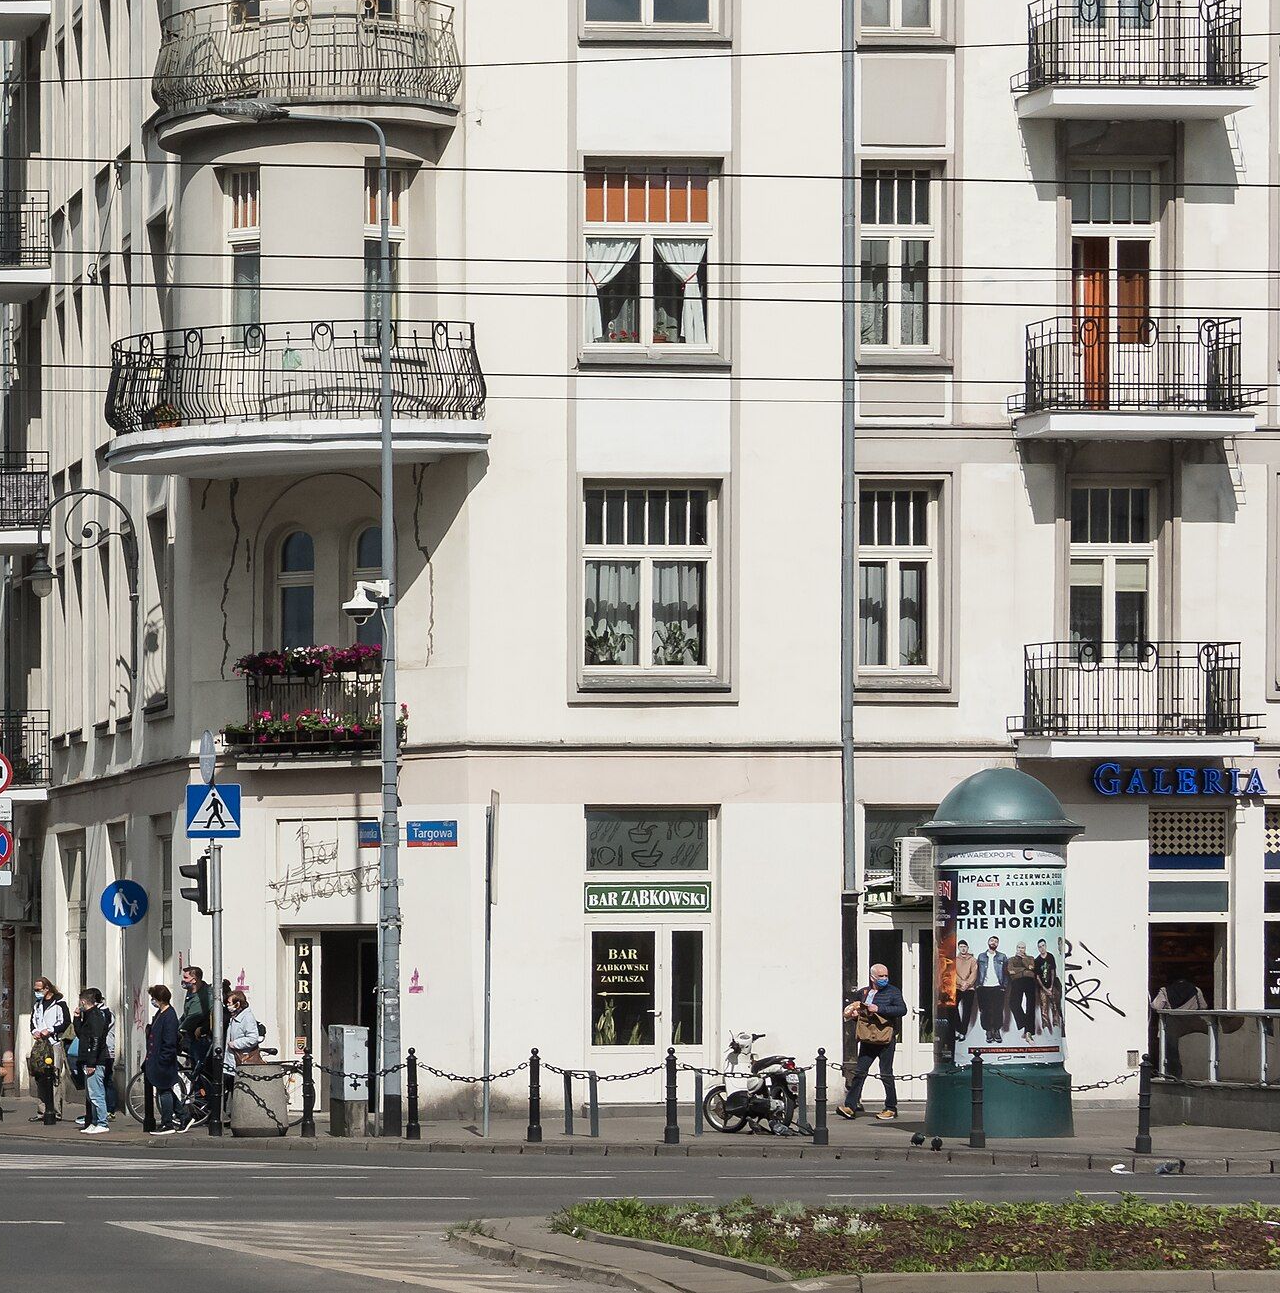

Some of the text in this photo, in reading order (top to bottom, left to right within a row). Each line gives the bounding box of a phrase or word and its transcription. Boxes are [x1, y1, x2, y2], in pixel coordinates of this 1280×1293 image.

[1093, 762, 1268, 796] GALERIA
[413, 827, 453, 841] Targowa
[958, 874, 1000, 883] IMPACT
[588, 889, 706, 908] BAR ZĄBKOWSKI
[867, 891, 892, 903] BA
[957, 898, 1035, 916] BRING
[1041, 897, 1062, 915] ME
[957, 916, 1062, 930] THE HORIZON
[608, 948, 638, 960] BAR
[297, 943, 310, 994] BAR
[596, 963, 649, 973] ZĄBKOWSKI
[600, 975, 645, 983] ZAPRASZA
